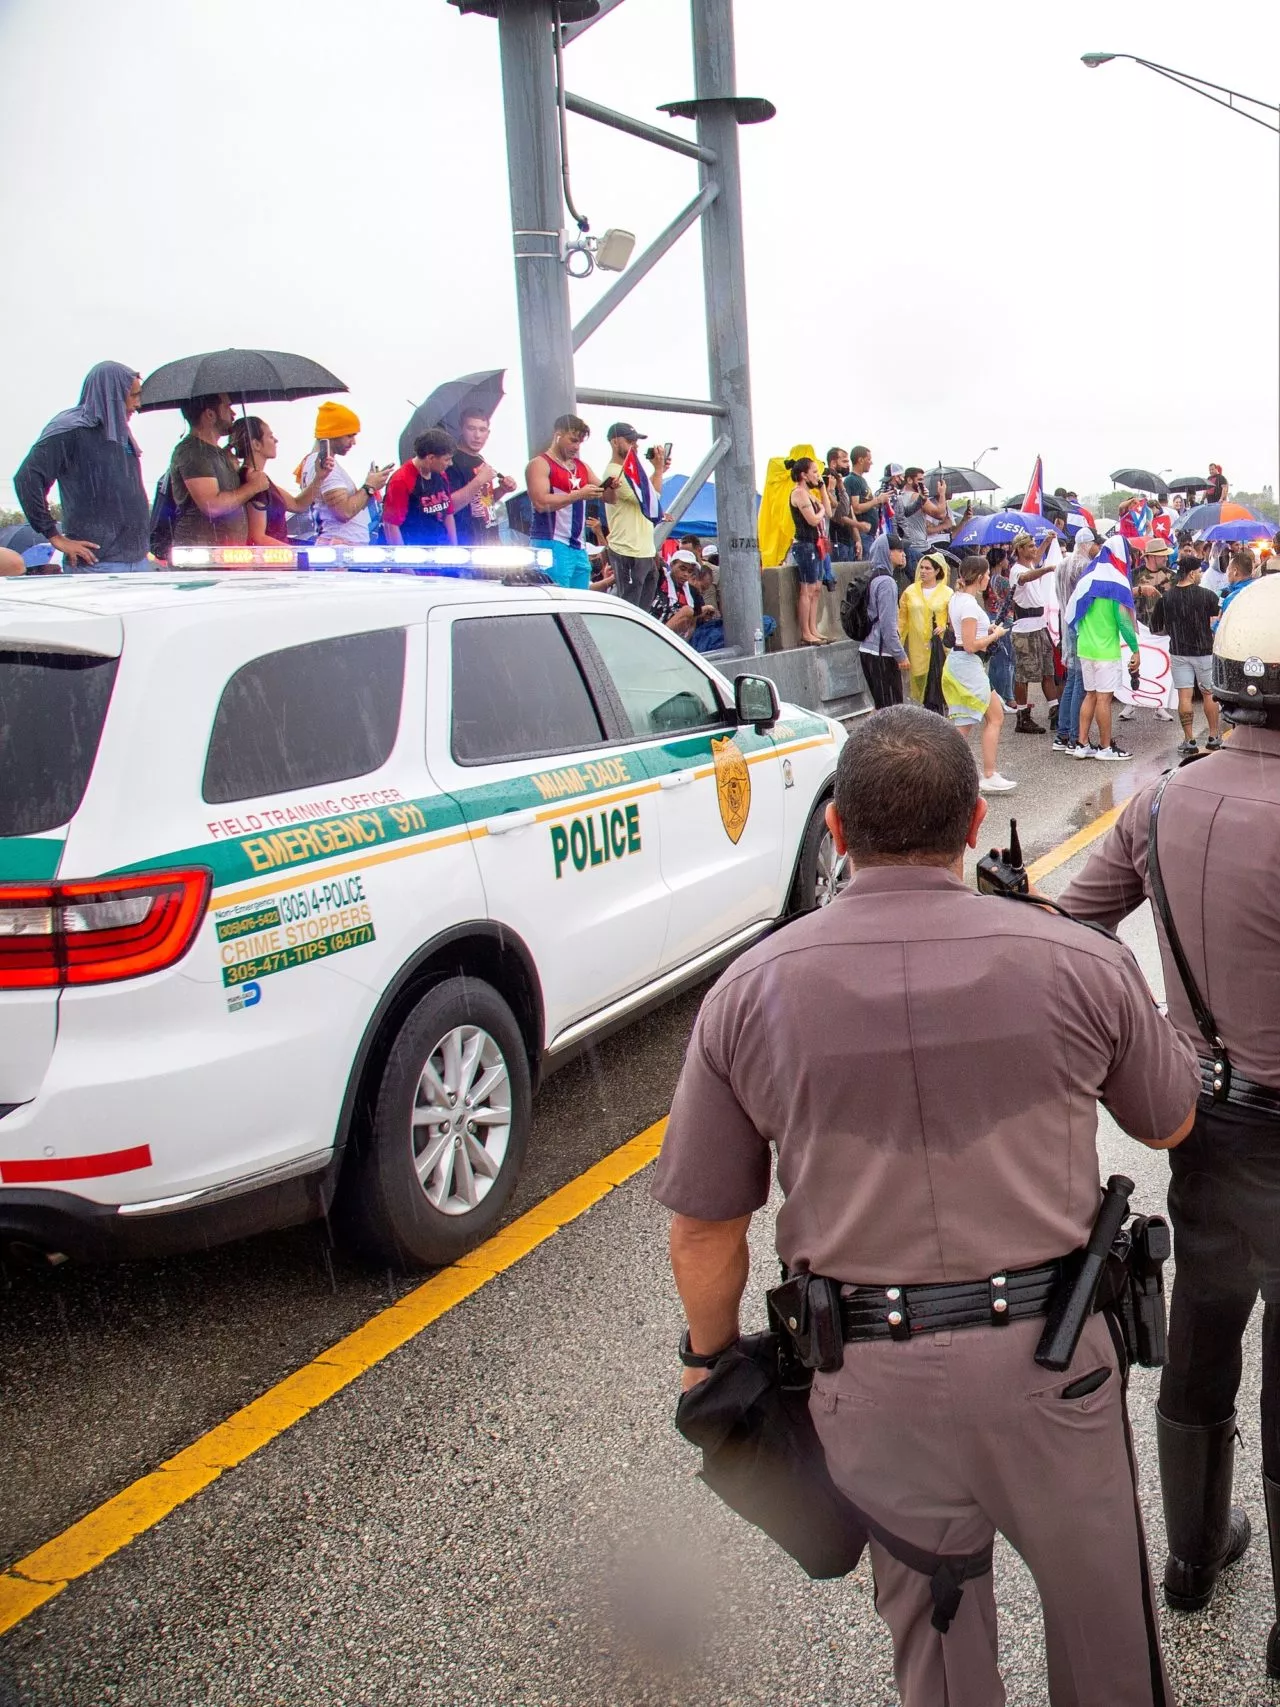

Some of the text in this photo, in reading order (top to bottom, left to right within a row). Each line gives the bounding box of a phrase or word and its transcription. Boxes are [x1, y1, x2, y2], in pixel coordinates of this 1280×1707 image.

[530, 757, 631, 801] MIAMI-DADE
[207, 788, 403, 839] FIELD TRAINING OFFICER
[240, 803, 426, 872] EMERGENCY 911
[549, 802, 642, 880] POLICE
[215, 897, 276, 919] Non-Emergency
[220, 904, 372, 966] CRIME STOPPERS
[227, 926, 371, 984] 305-471-TIPS (8477)
